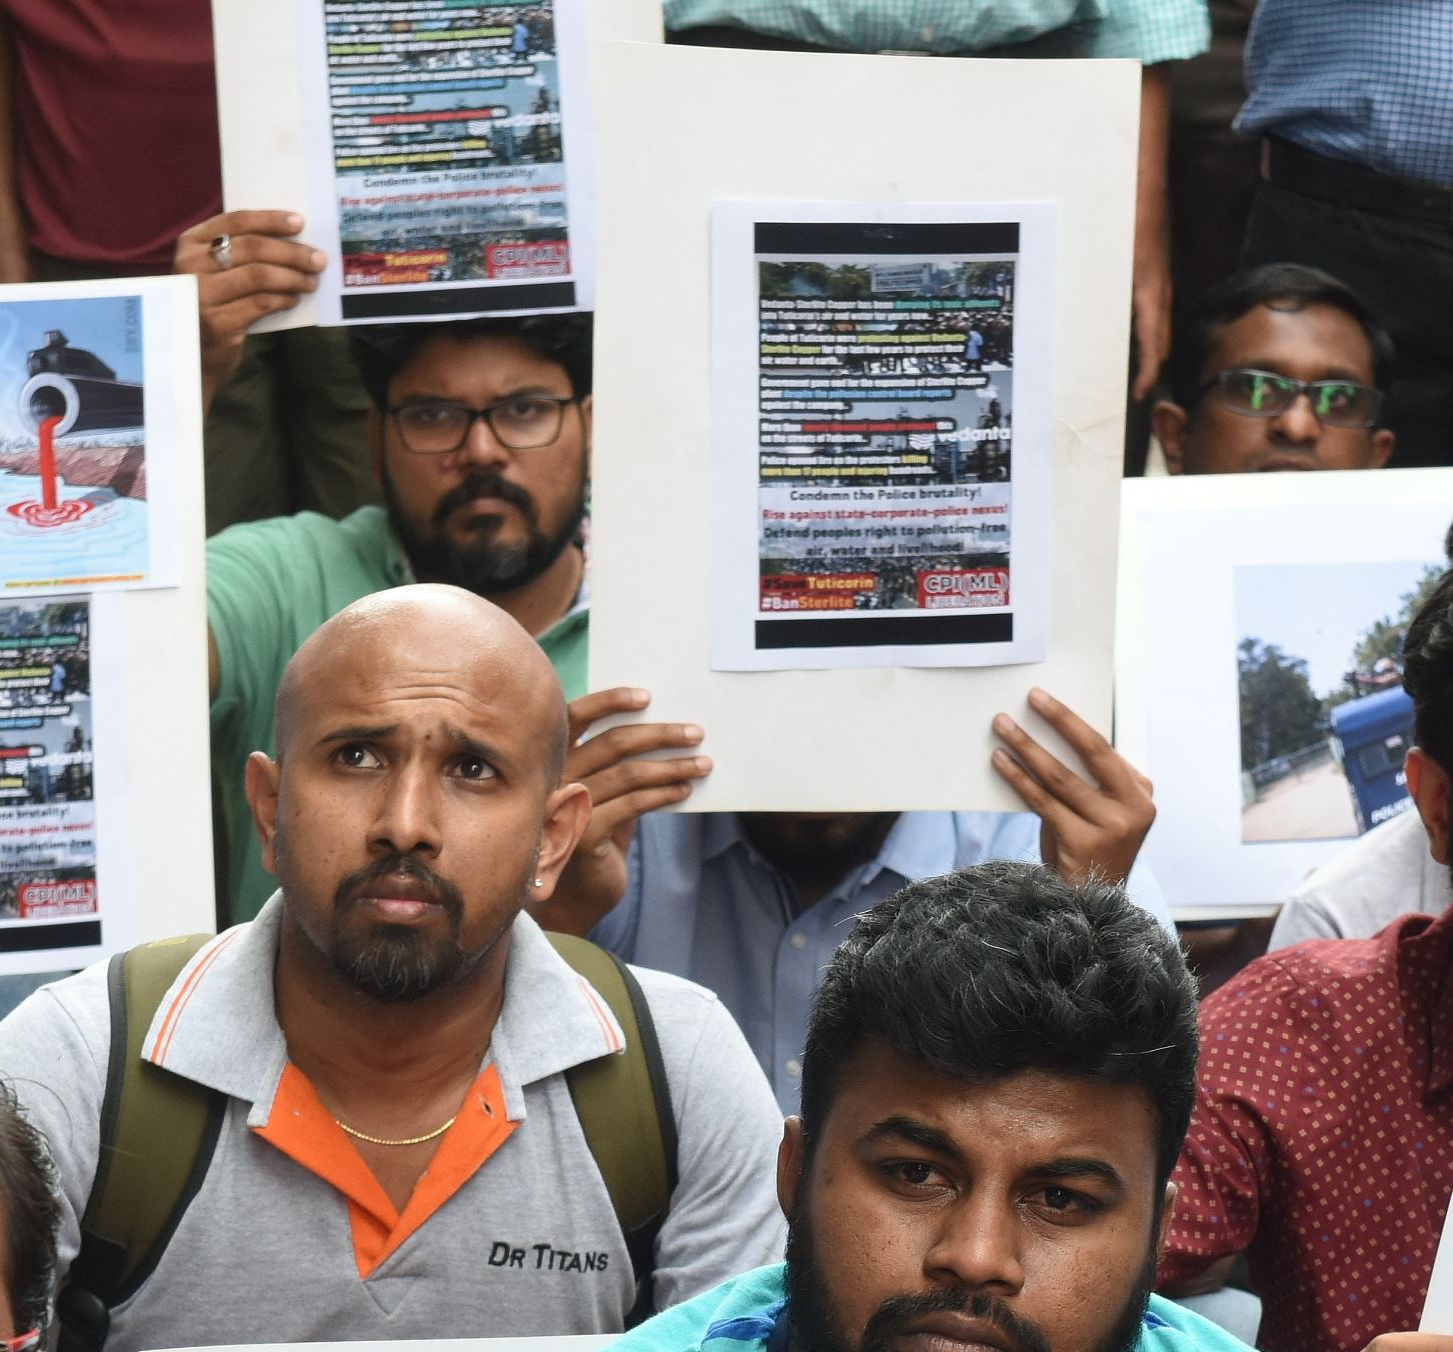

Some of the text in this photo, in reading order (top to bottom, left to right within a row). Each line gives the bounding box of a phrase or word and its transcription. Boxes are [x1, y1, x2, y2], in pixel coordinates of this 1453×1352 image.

[790, 491, 850, 501] Condemn
[854, 490, 873, 500] the
[878, 490, 917, 500] Police
